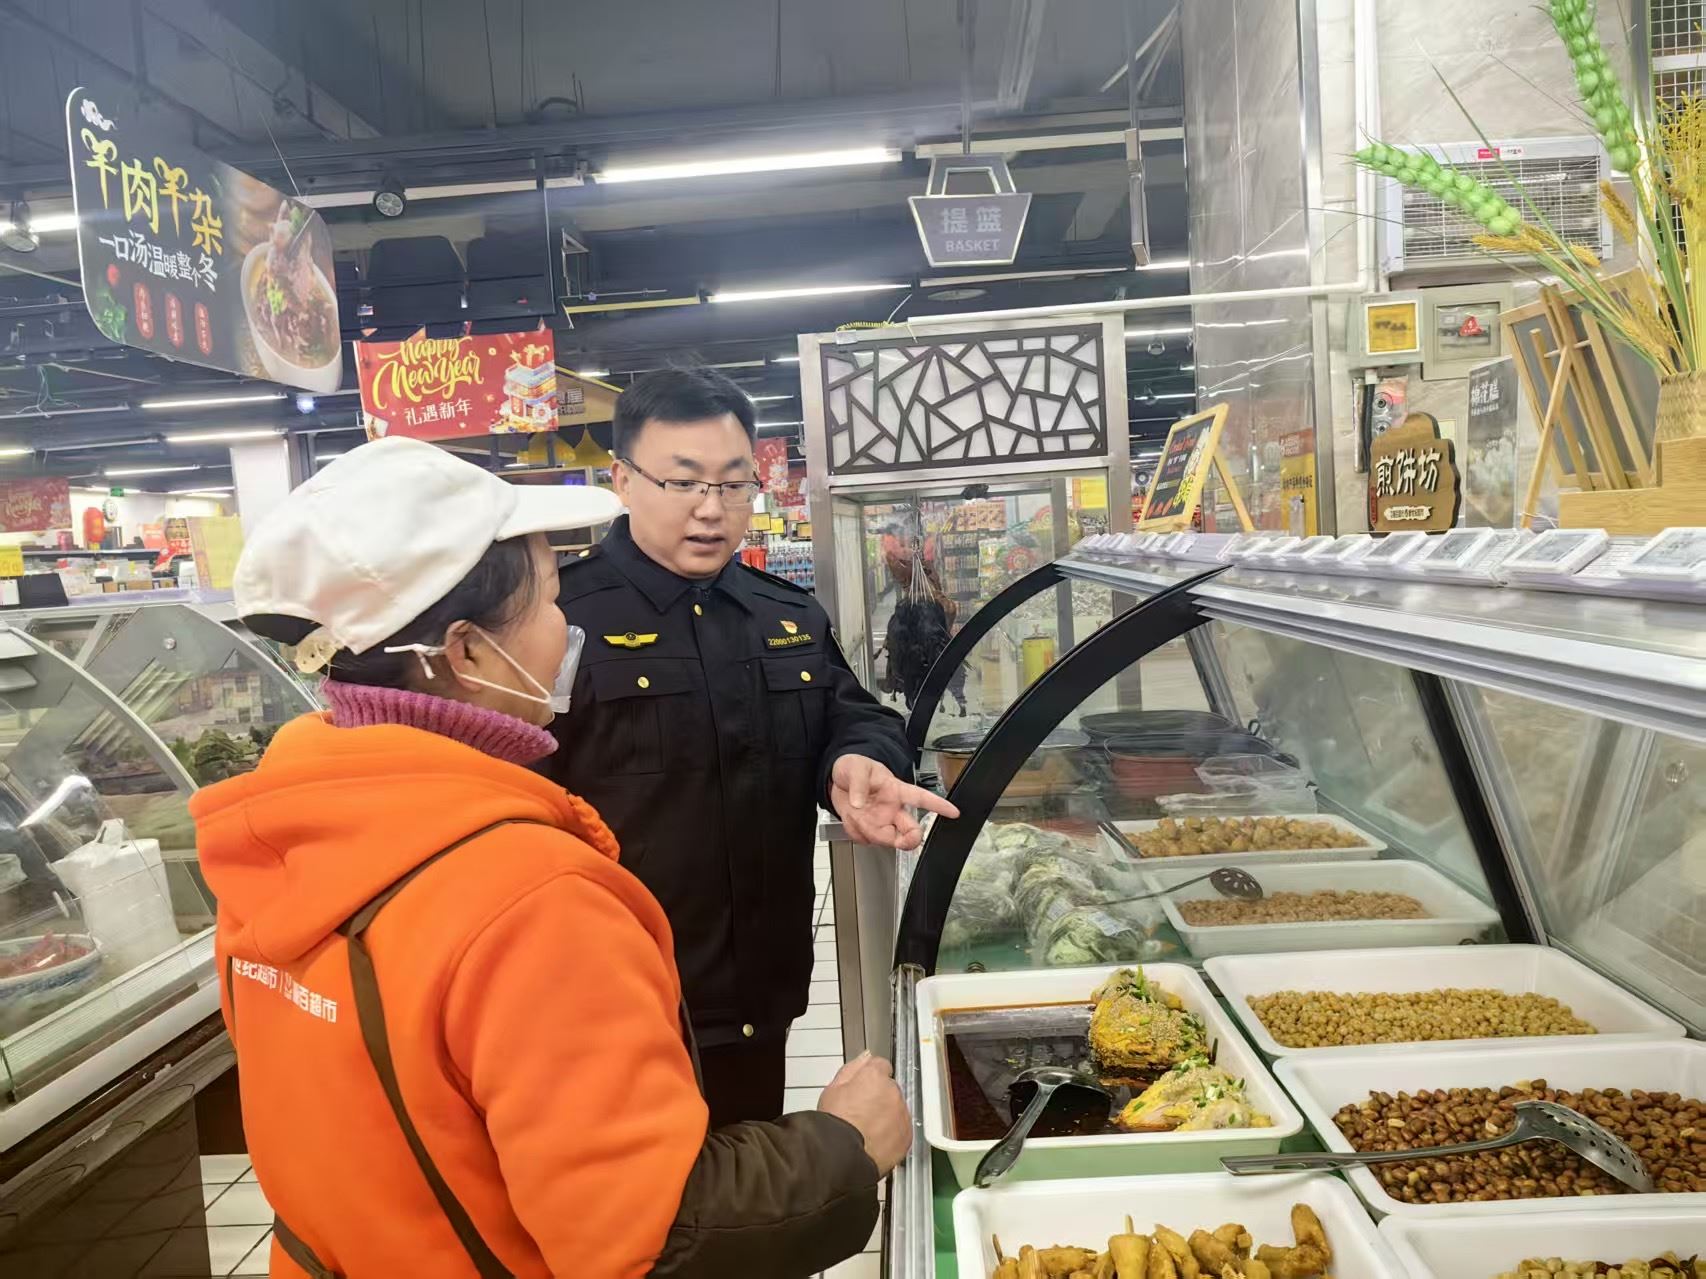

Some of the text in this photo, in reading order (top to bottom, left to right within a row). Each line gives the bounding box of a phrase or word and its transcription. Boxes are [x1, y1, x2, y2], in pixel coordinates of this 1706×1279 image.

[81, 128, 223, 256] 羊肉羊杂
[942, 206, 1002, 234] 提篮
[945, 239, 1000, 252] BASKET
[98, 230, 218, 292] 一口汤温暖整个冬
[372, 350, 485, 410] New Year
[404, 398, 473, 426] 礼遇新年
[1375, 447, 1441, 498] 煎饼坊
